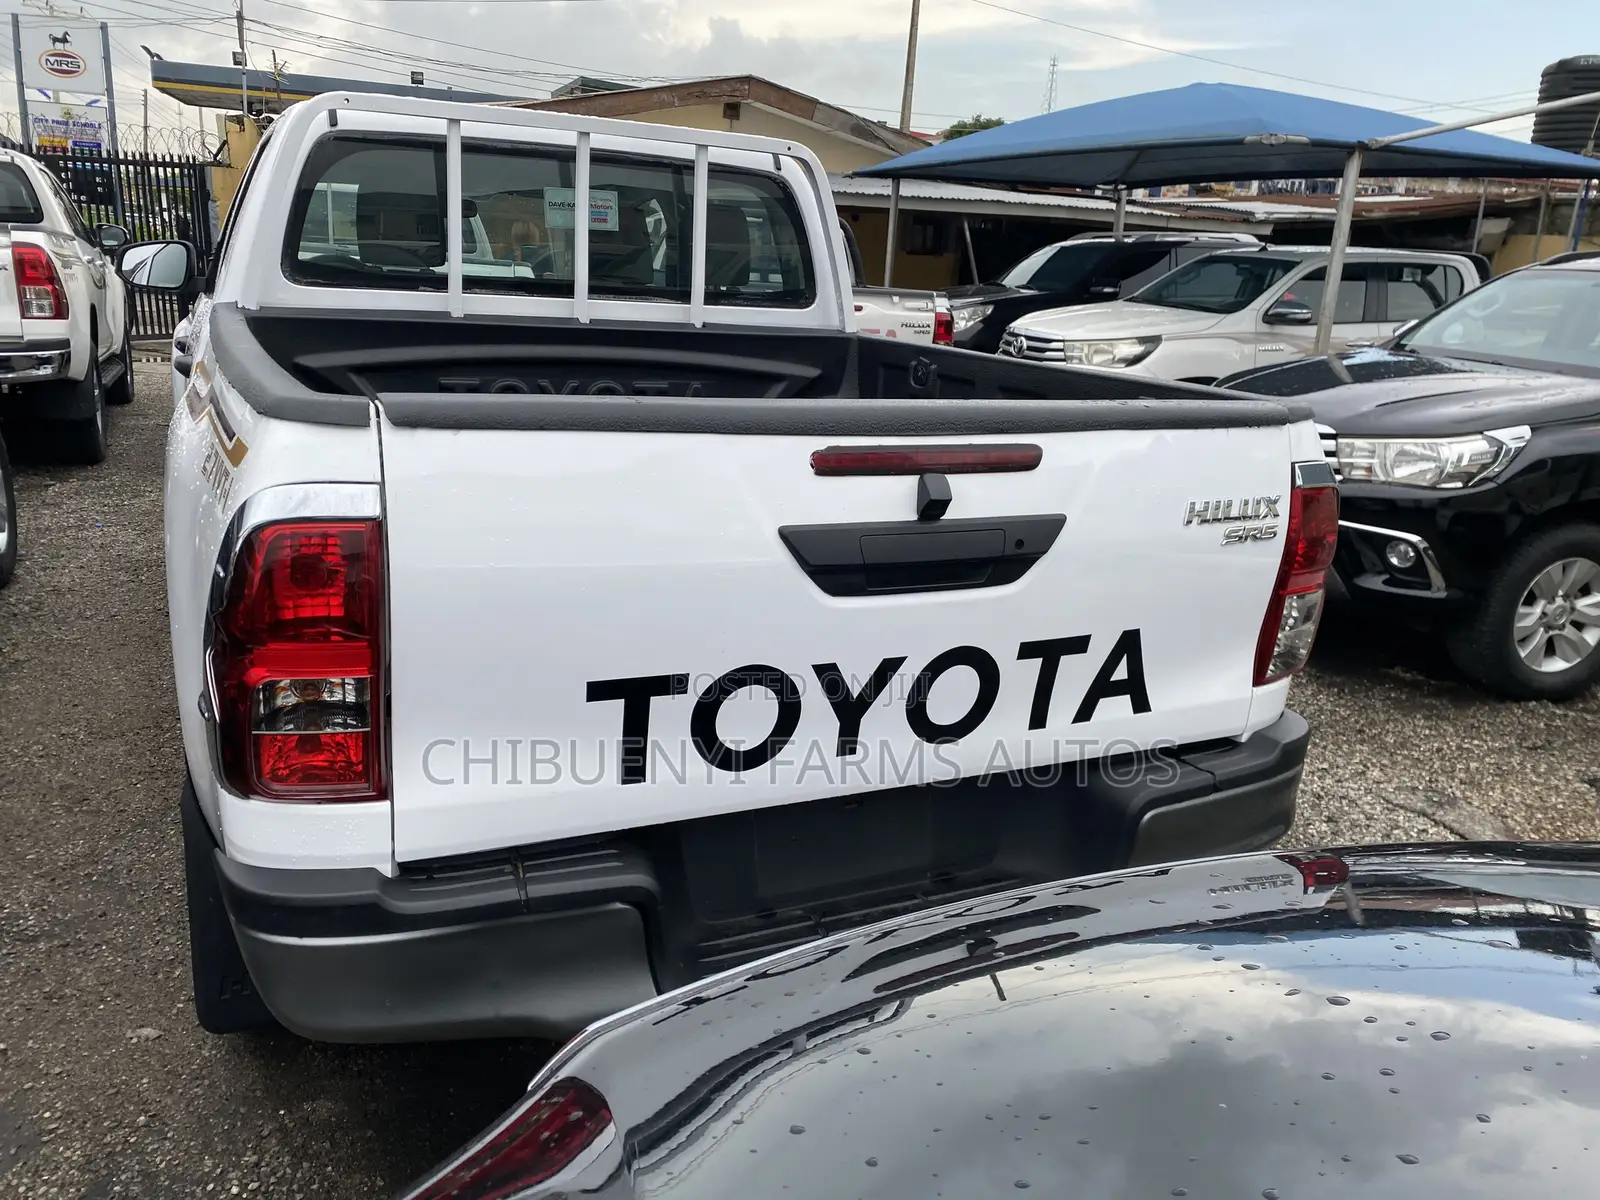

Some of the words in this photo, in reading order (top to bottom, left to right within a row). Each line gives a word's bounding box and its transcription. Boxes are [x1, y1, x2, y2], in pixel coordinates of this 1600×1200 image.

[45, 57, 81, 70] MRS
[548, 201, 576, 209] DAVE-KA
[1184, 495, 1280, 525] HILUX
[1220, 522, 1279, 546] SR5
[586, 628, 1152, 786] TOYOTA
